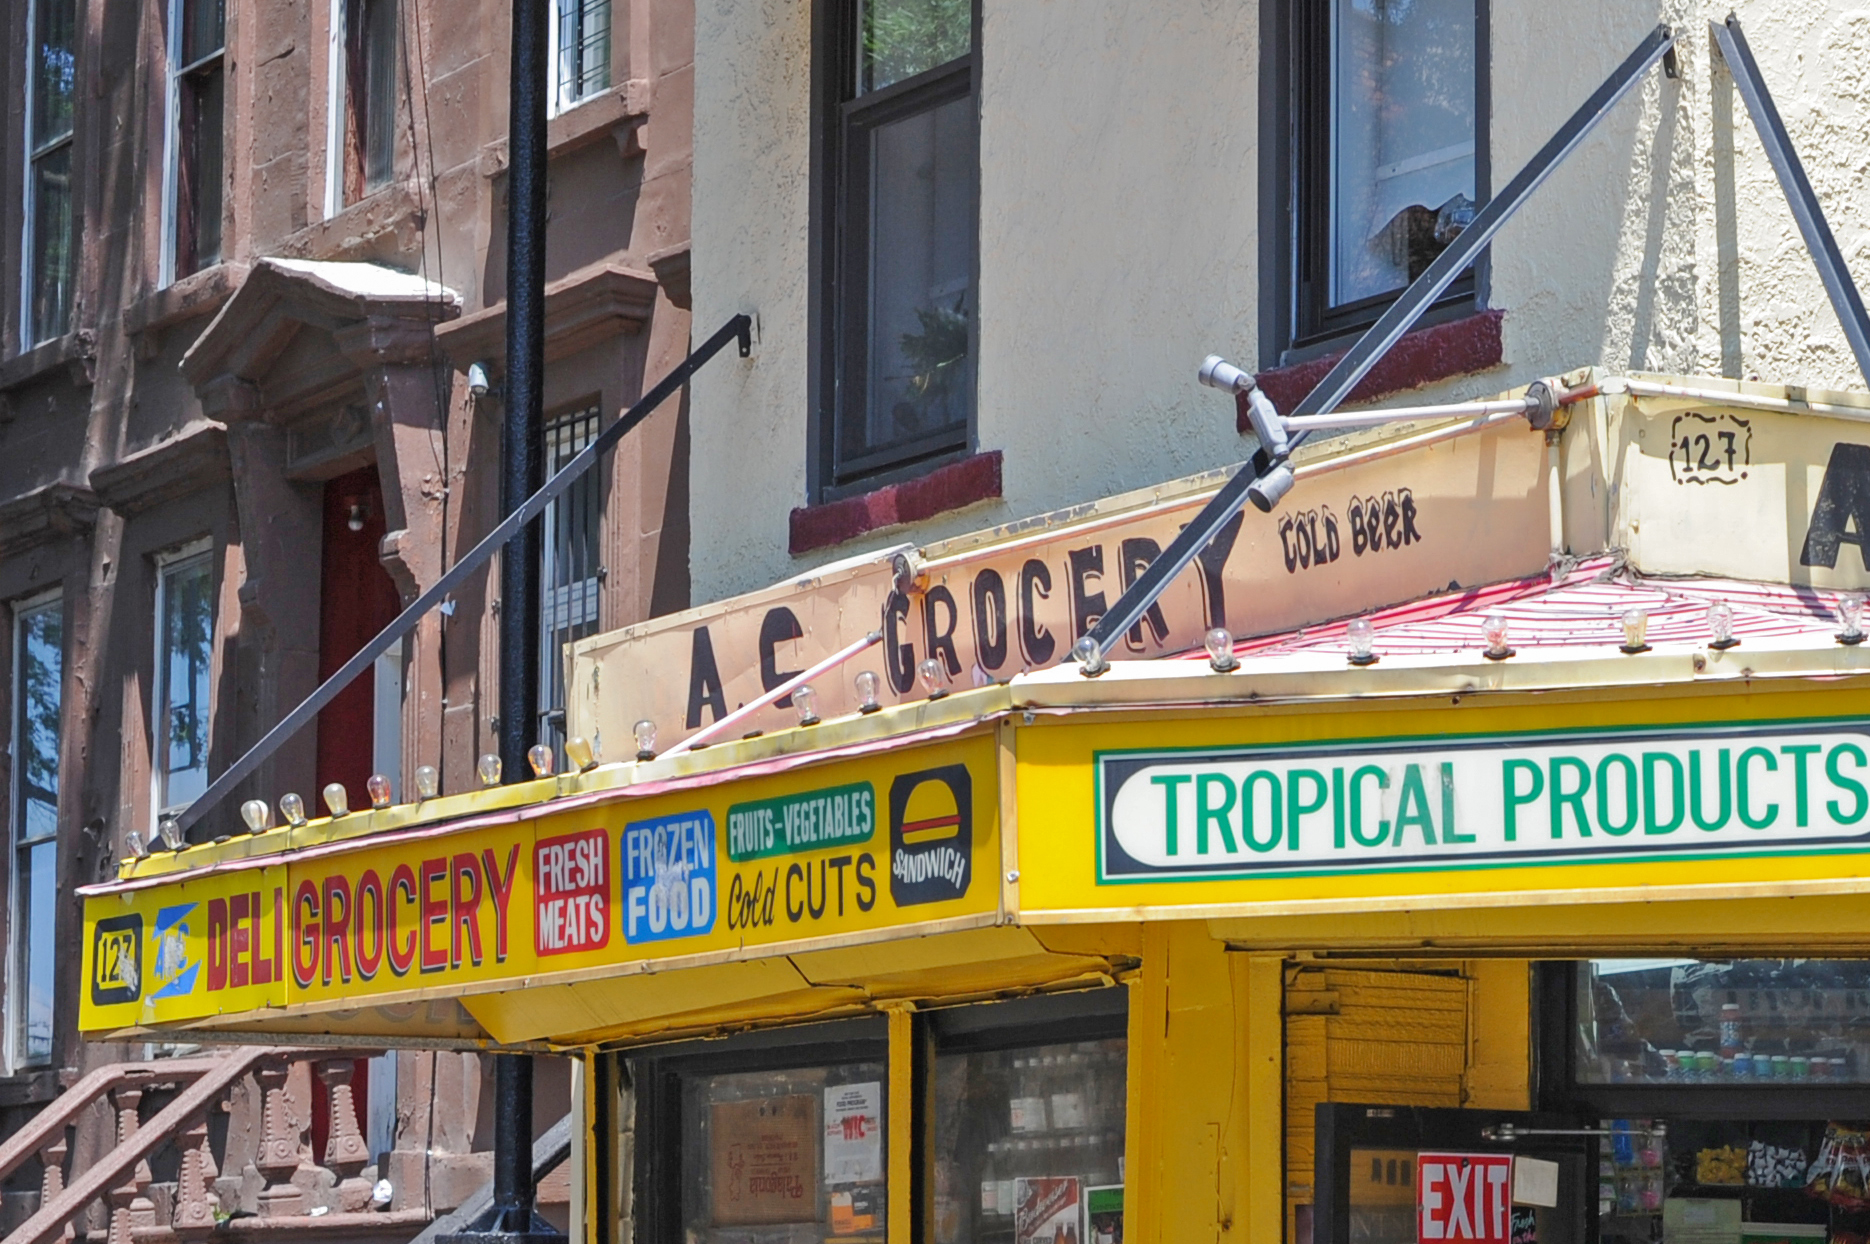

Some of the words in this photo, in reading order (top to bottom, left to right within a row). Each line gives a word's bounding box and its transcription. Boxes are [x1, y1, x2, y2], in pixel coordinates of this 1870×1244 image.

[1679, 430, 1738, 473] 127
[882, 509, 1245, 695] GROCERY
[1278, 503, 1341, 574] COLD
[1150, 760, 1477, 858] TROPICAL
[1503, 742, 1870, 843] PRODUCTS
[538, 836, 602, 896] FRESH
[627, 817, 710, 881] FROZEN
[892, 845, 966, 891] SANDWICH
[207, 886, 283, 992] DELI
[291, 843, 521, 989] GROCERY
[628, 877, 711, 938] FOOD
[728, 866, 779, 931] Cold
[786, 852, 876, 923] CUTS
[539, 895, 604, 951] MEATS
[98, 925, 134, 986] 127
[842, 1115, 866, 1140] WIC
[1423, 1163, 1508, 1239] EXIT
[1511, 1209, 1536, 1229] Fresh
